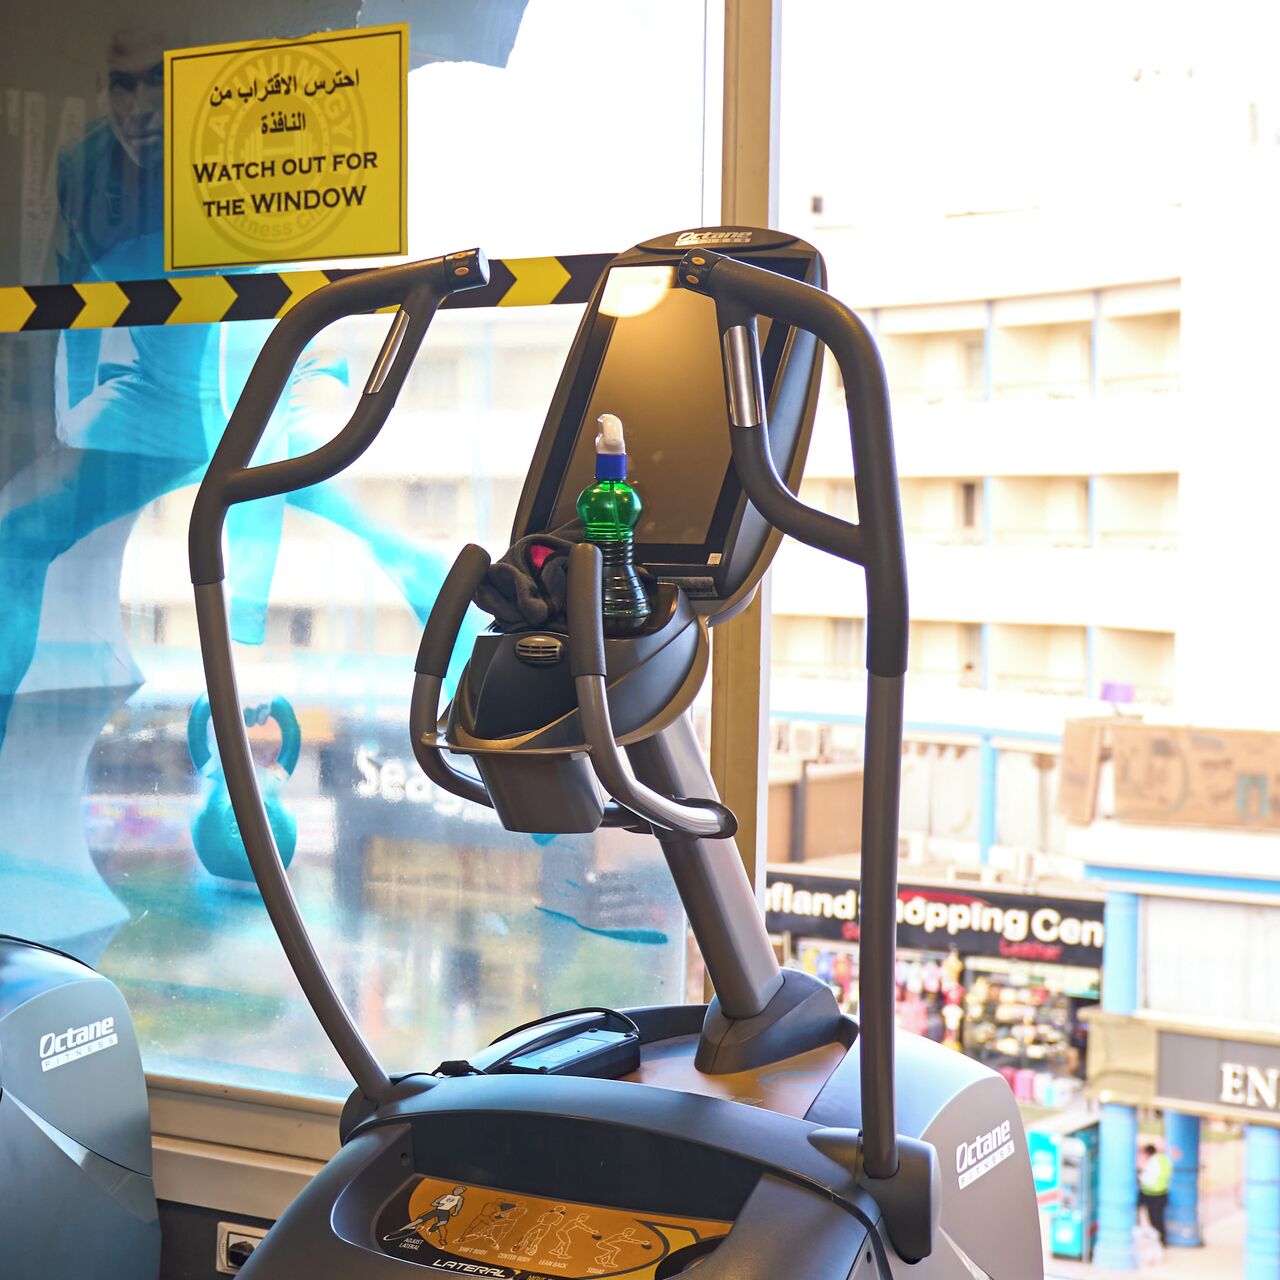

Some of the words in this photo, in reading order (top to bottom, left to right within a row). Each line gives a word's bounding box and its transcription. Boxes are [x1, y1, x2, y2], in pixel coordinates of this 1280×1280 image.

[209, 85, 233, 107] من
[237, 72, 298, 104] الاقتراب
[303, 67, 360, 97] احترس
[260, 111, 307, 135] النافذة
[282, 156, 326, 175] OUT
[332, 151, 378, 172] FOR
[203, 198, 245, 218] THE
[251, 185, 367, 214] WINDOW
[39, 1016, 115, 1059] Octane
[45, 1038, 115, 1069] FITNESS
[955, 1119, 1011, 1174] Octane
[432, 1258, 506, 1278] LATERAL
